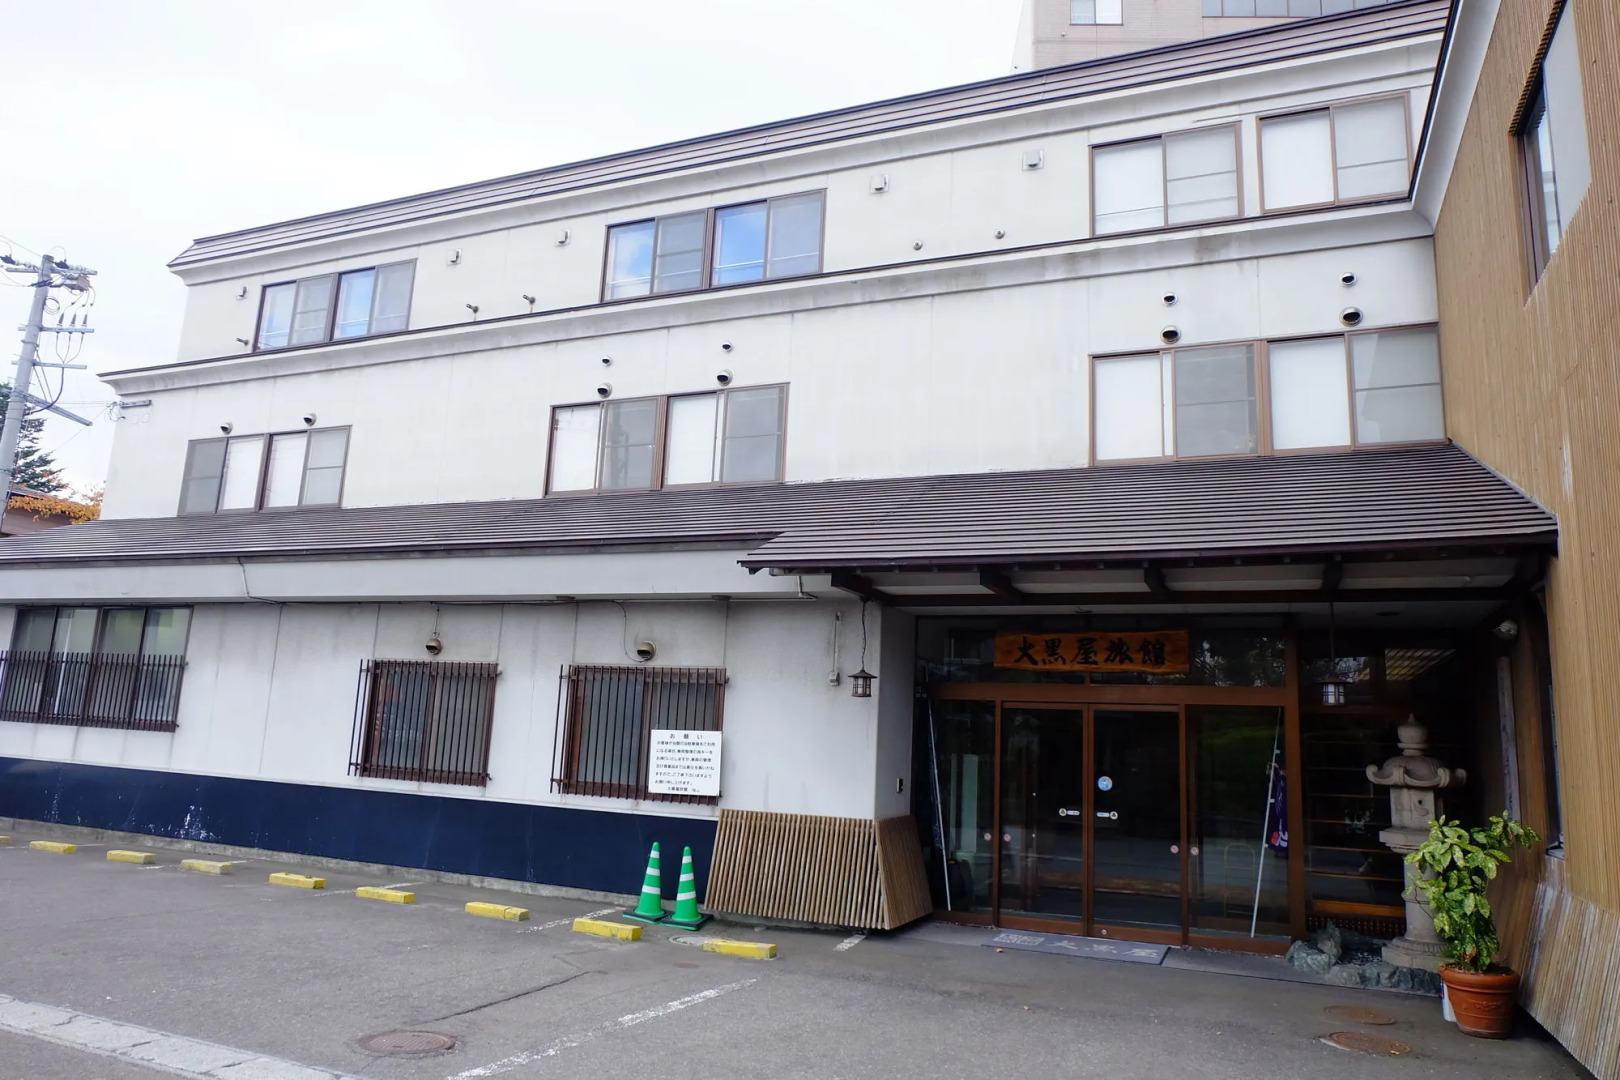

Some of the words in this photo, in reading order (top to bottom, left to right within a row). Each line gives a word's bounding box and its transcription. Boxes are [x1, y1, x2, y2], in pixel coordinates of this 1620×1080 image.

[1014, 636, 1167, 666] 大黒屋旅館
